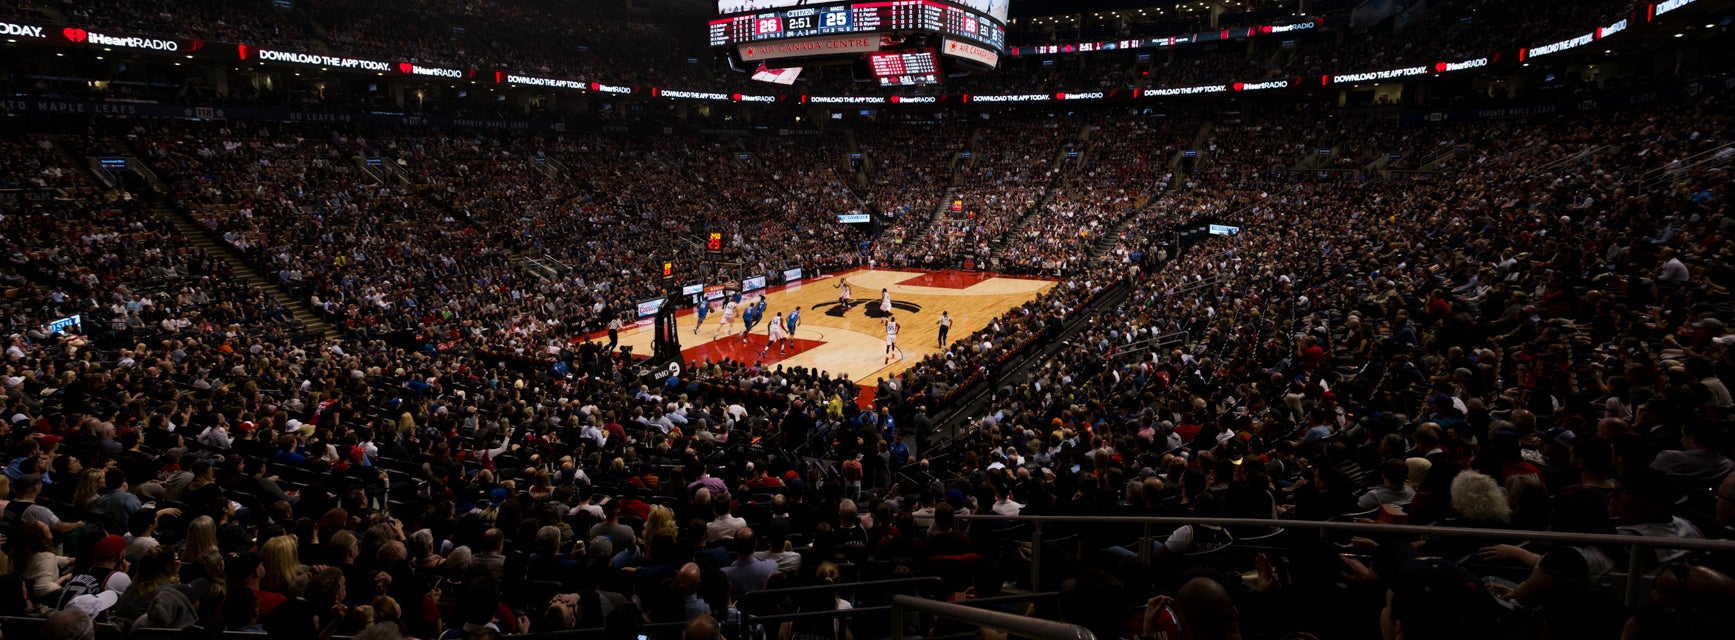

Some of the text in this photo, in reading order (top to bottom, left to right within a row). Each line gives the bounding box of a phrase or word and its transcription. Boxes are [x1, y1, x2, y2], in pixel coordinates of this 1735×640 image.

[787, 8, 815, 17] CITIZEN
[789, 17, 811, 29] 2:51
[826, 12, 847, 26] 25
[965, 18, 976, 32] 26
[759, 19, 777, 33] 26
[1272, 21, 1314, 33] iHeartRADIO
[88, 31, 178, 51] iHeartRADIO
[760, 38, 870, 54] AIR CANADA CENTRE
[960, 44, 969, 53] AIR
[1529, 41, 1558, 58] DOWNLOAD
[1558, 39, 1569, 51] THE
[259, 49, 391, 71] DOWNLOAD THE APP TODAY.
[1445, 58, 1487, 71] iHeartRADIO
[412, 65, 462, 78] iHeartRADIO
[1334, 66, 1427, 83] DOWNLOAD THE APP TODAY.
[507, 75, 586, 89] DOWNLOAD THE APP TODAY.
[1243, 80, 1287, 90] iHeartRADIO
[600, 84, 631, 94] iHeartRADIO
[661, 90, 690, 98] DOWNLOAD
[1144, 88, 1180, 96] DOWNLOAD
[1065, 92, 1103, 100] iHeartRADIO
[38, 101, 85, 112] MAPLE
[95, 104, 136, 115] LEAFS
[307, 113, 335, 121] LEAFS
[708, 239, 720, 249] 23
[654, 369, 669, 380] BMO
